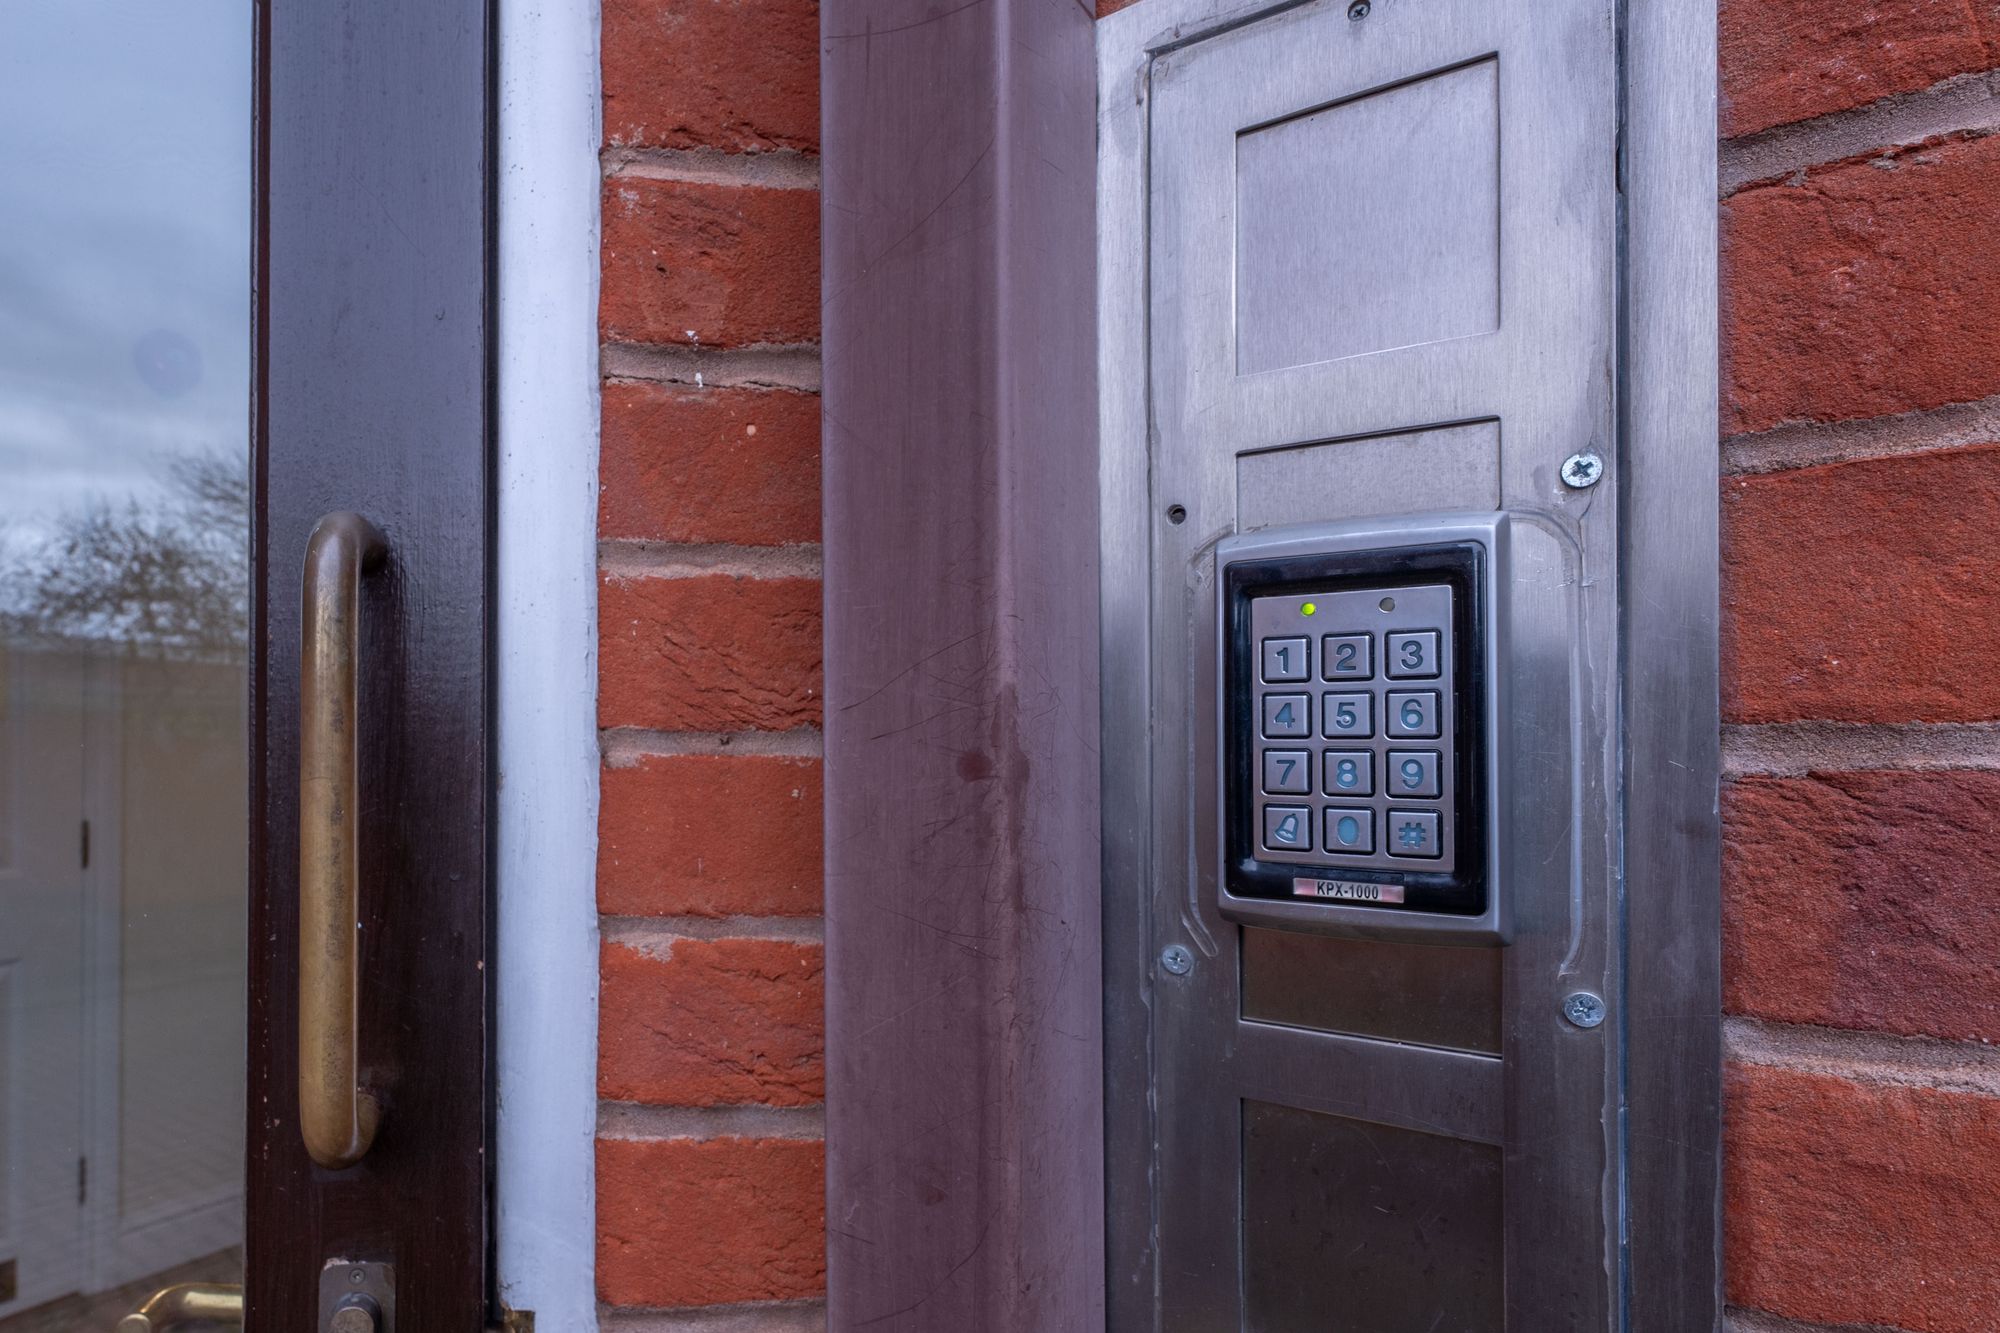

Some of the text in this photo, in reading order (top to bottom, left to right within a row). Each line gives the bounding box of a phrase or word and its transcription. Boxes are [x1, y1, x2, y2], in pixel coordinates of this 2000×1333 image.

[1275, 640, 1424, 673] 1 2 3
[1274, 699, 1424, 729] 4 5 6
[1276, 759, 1424, 789] 7 8 9
[1337, 816, 1426, 848] 0 #
[1317, 881, 1379, 899] KPX-1000
